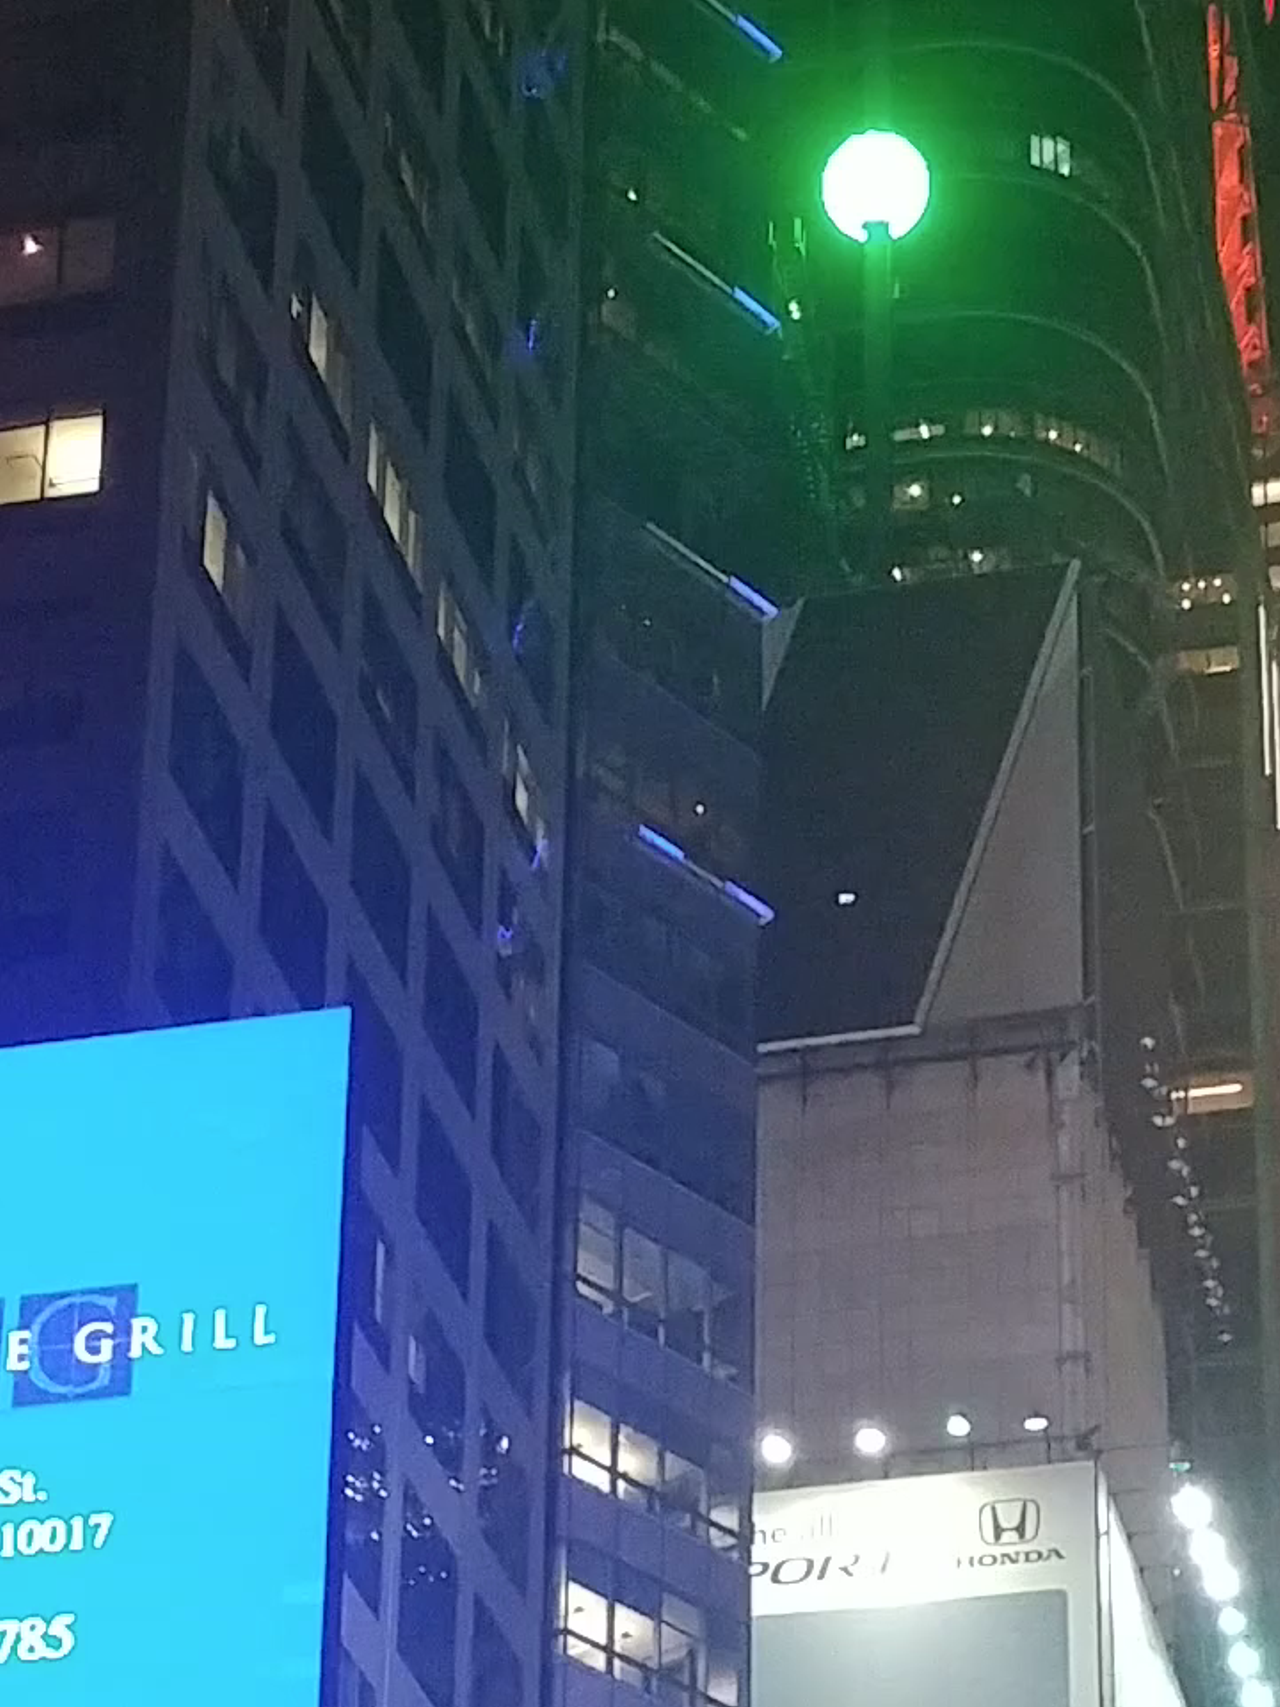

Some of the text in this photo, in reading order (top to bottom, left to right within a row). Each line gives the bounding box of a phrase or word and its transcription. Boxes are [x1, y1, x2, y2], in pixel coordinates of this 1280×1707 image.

[71, 1302, 278, 1365] GRILL
[0, 1511, 114, 1559] 10017
[956, 1547, 1067, 1570] HONDA
